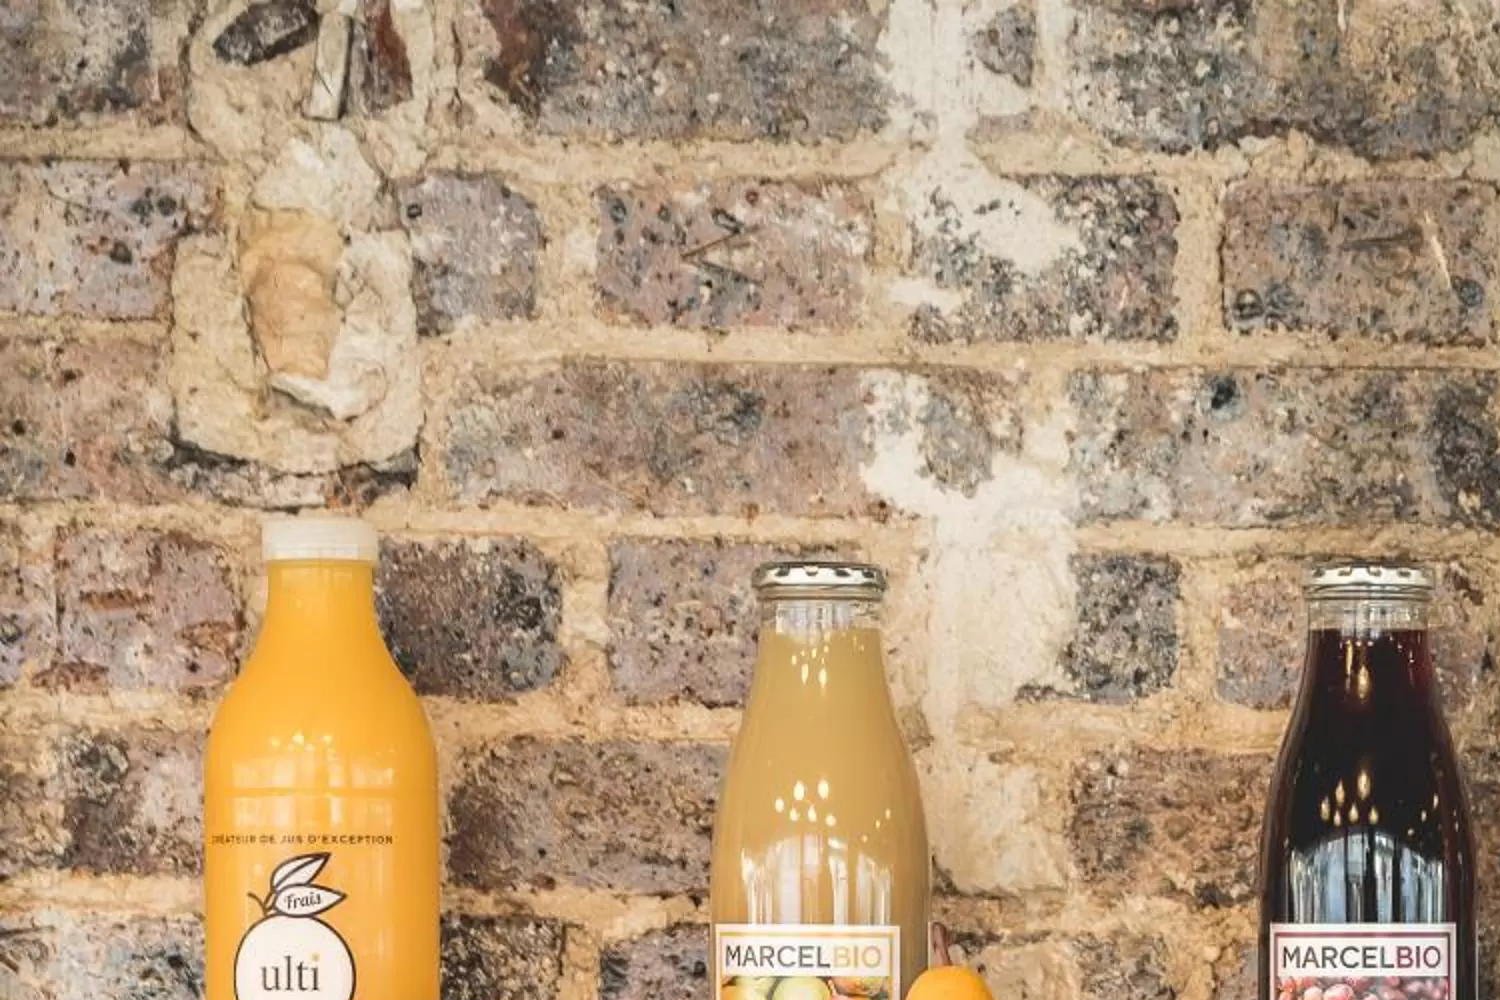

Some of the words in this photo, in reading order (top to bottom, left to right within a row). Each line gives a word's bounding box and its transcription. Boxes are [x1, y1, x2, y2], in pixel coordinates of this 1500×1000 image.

[259, 835, 275, 845] DE
[280, 835, 304, 845] JUS
[307, 835, 393, 845] D'EXCEPTION
[725, 945, 882, 969] MARCELBIO
[1281, 945, 1442, 969] MARCELBIO
[260, 952, 321, 992] ulti
